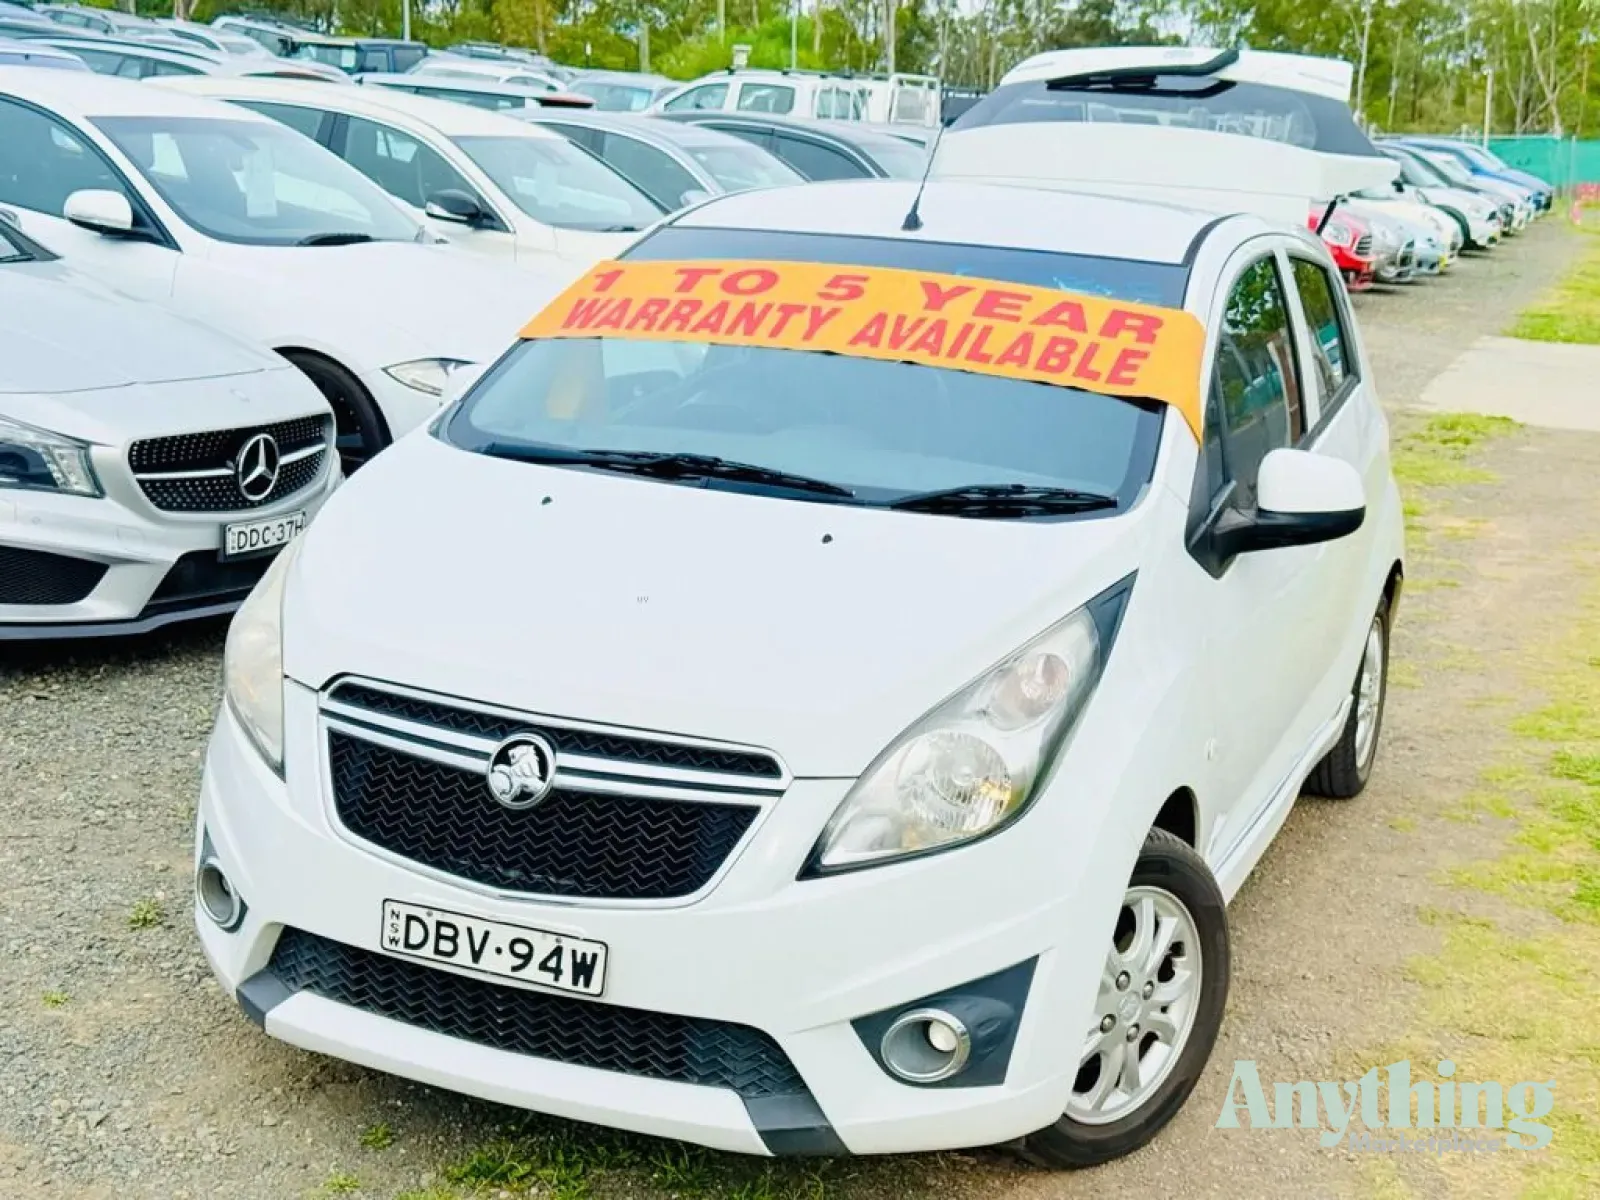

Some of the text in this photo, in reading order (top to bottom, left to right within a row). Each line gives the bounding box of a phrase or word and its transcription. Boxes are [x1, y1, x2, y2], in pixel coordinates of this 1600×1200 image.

[560, 298, 1151, 387] WARRANTY AVAILABLE
[592, 268, 1164, 345] 1 TO 5 YEAR
[388, 909, 401, 948] NSW
